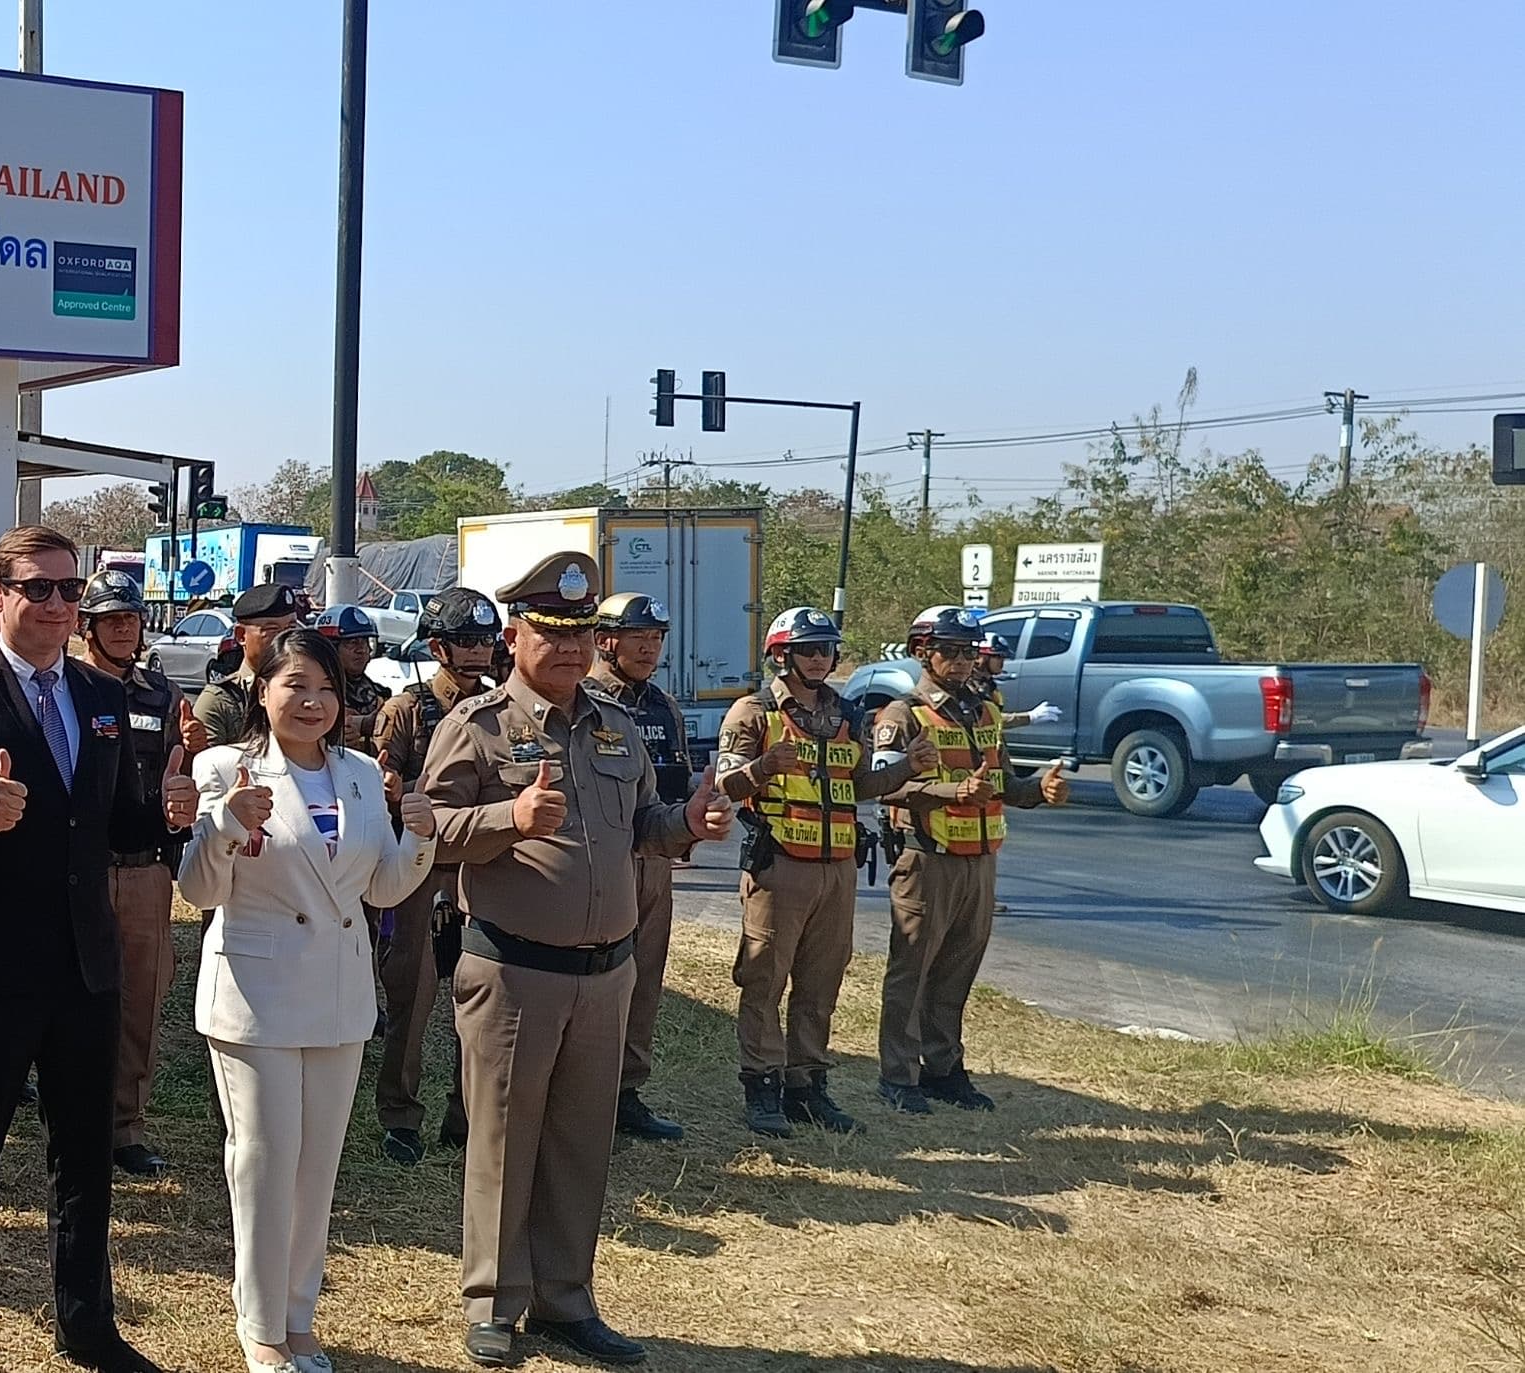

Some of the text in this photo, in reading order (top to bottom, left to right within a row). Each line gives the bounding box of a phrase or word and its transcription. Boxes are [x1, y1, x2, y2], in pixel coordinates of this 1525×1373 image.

[57, 298, 131, 313] Approved Centre
[1038, 548, 1098, 565] นครราชสีมา
[972, 564, 980, 581] 2
[831, 782, 852, 801] 618
